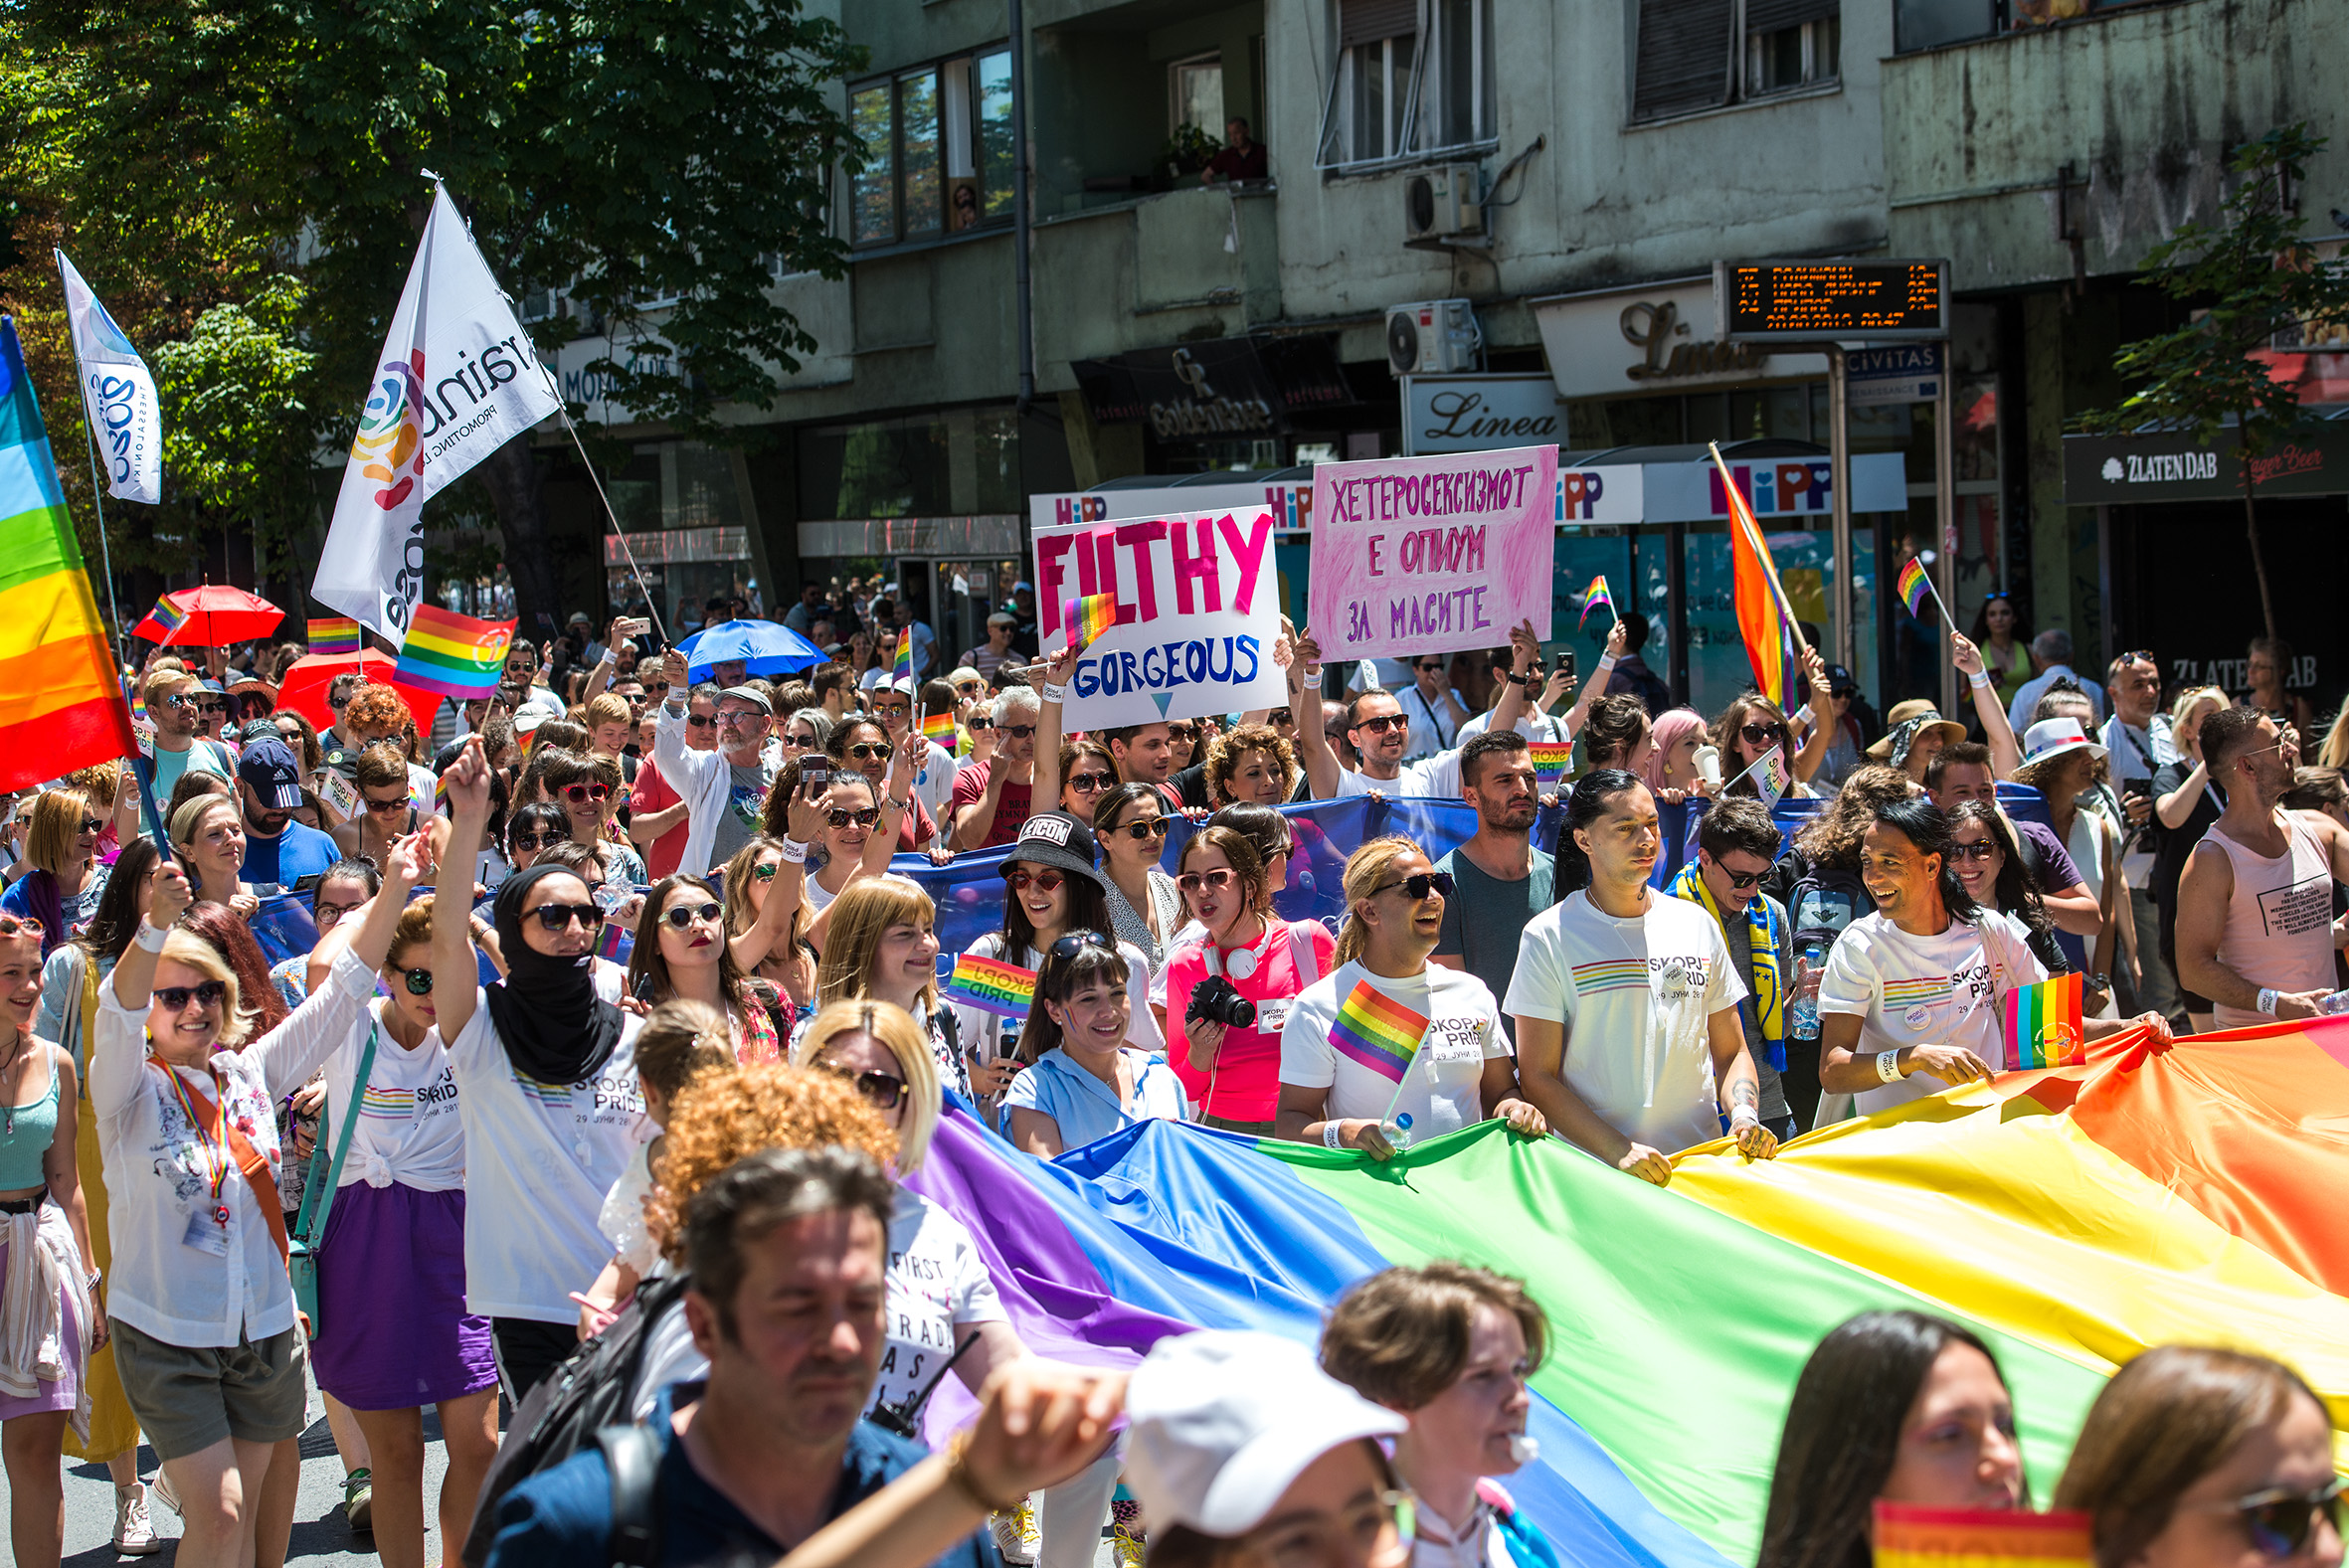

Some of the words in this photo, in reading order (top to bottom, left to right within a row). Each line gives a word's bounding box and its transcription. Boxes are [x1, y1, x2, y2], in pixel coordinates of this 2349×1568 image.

[1425, 391, 1557, 439] Linea
[2126, 453, 2185, 483] ZLATEN
[2185, 451, 2218, 480] DAB
[2283, 443, 2323, 472] Beer
[1265, 486, 1312, 529] HiP
[1330, 464, 1534, 524] ХЕТЕРОСЕКСИЗМОТ
[1368, 534, 1384, 577] Е
[1399, 525, 1487, 575] ОПИУМ
[1037, 512, 1275, 639] FILTHY
[1347, 600, 1374, 643] ЗА
[1390, 585, 1491, 640] МАСИТЕ
[1073, 633, 1260, 699] GORGEOUS
[2284, 655, 2317, 688] AB
[1031, 820, 1068, 843] ICON
[2270, 903, 2298, 914] MEMORIES
[2287, 926, 2310, 936] FOREVER
[444, 1103, 460, 1114] 201
[576, 1115, 588, 1124] 29
[891, 1252, 944, 1281] FIRST
